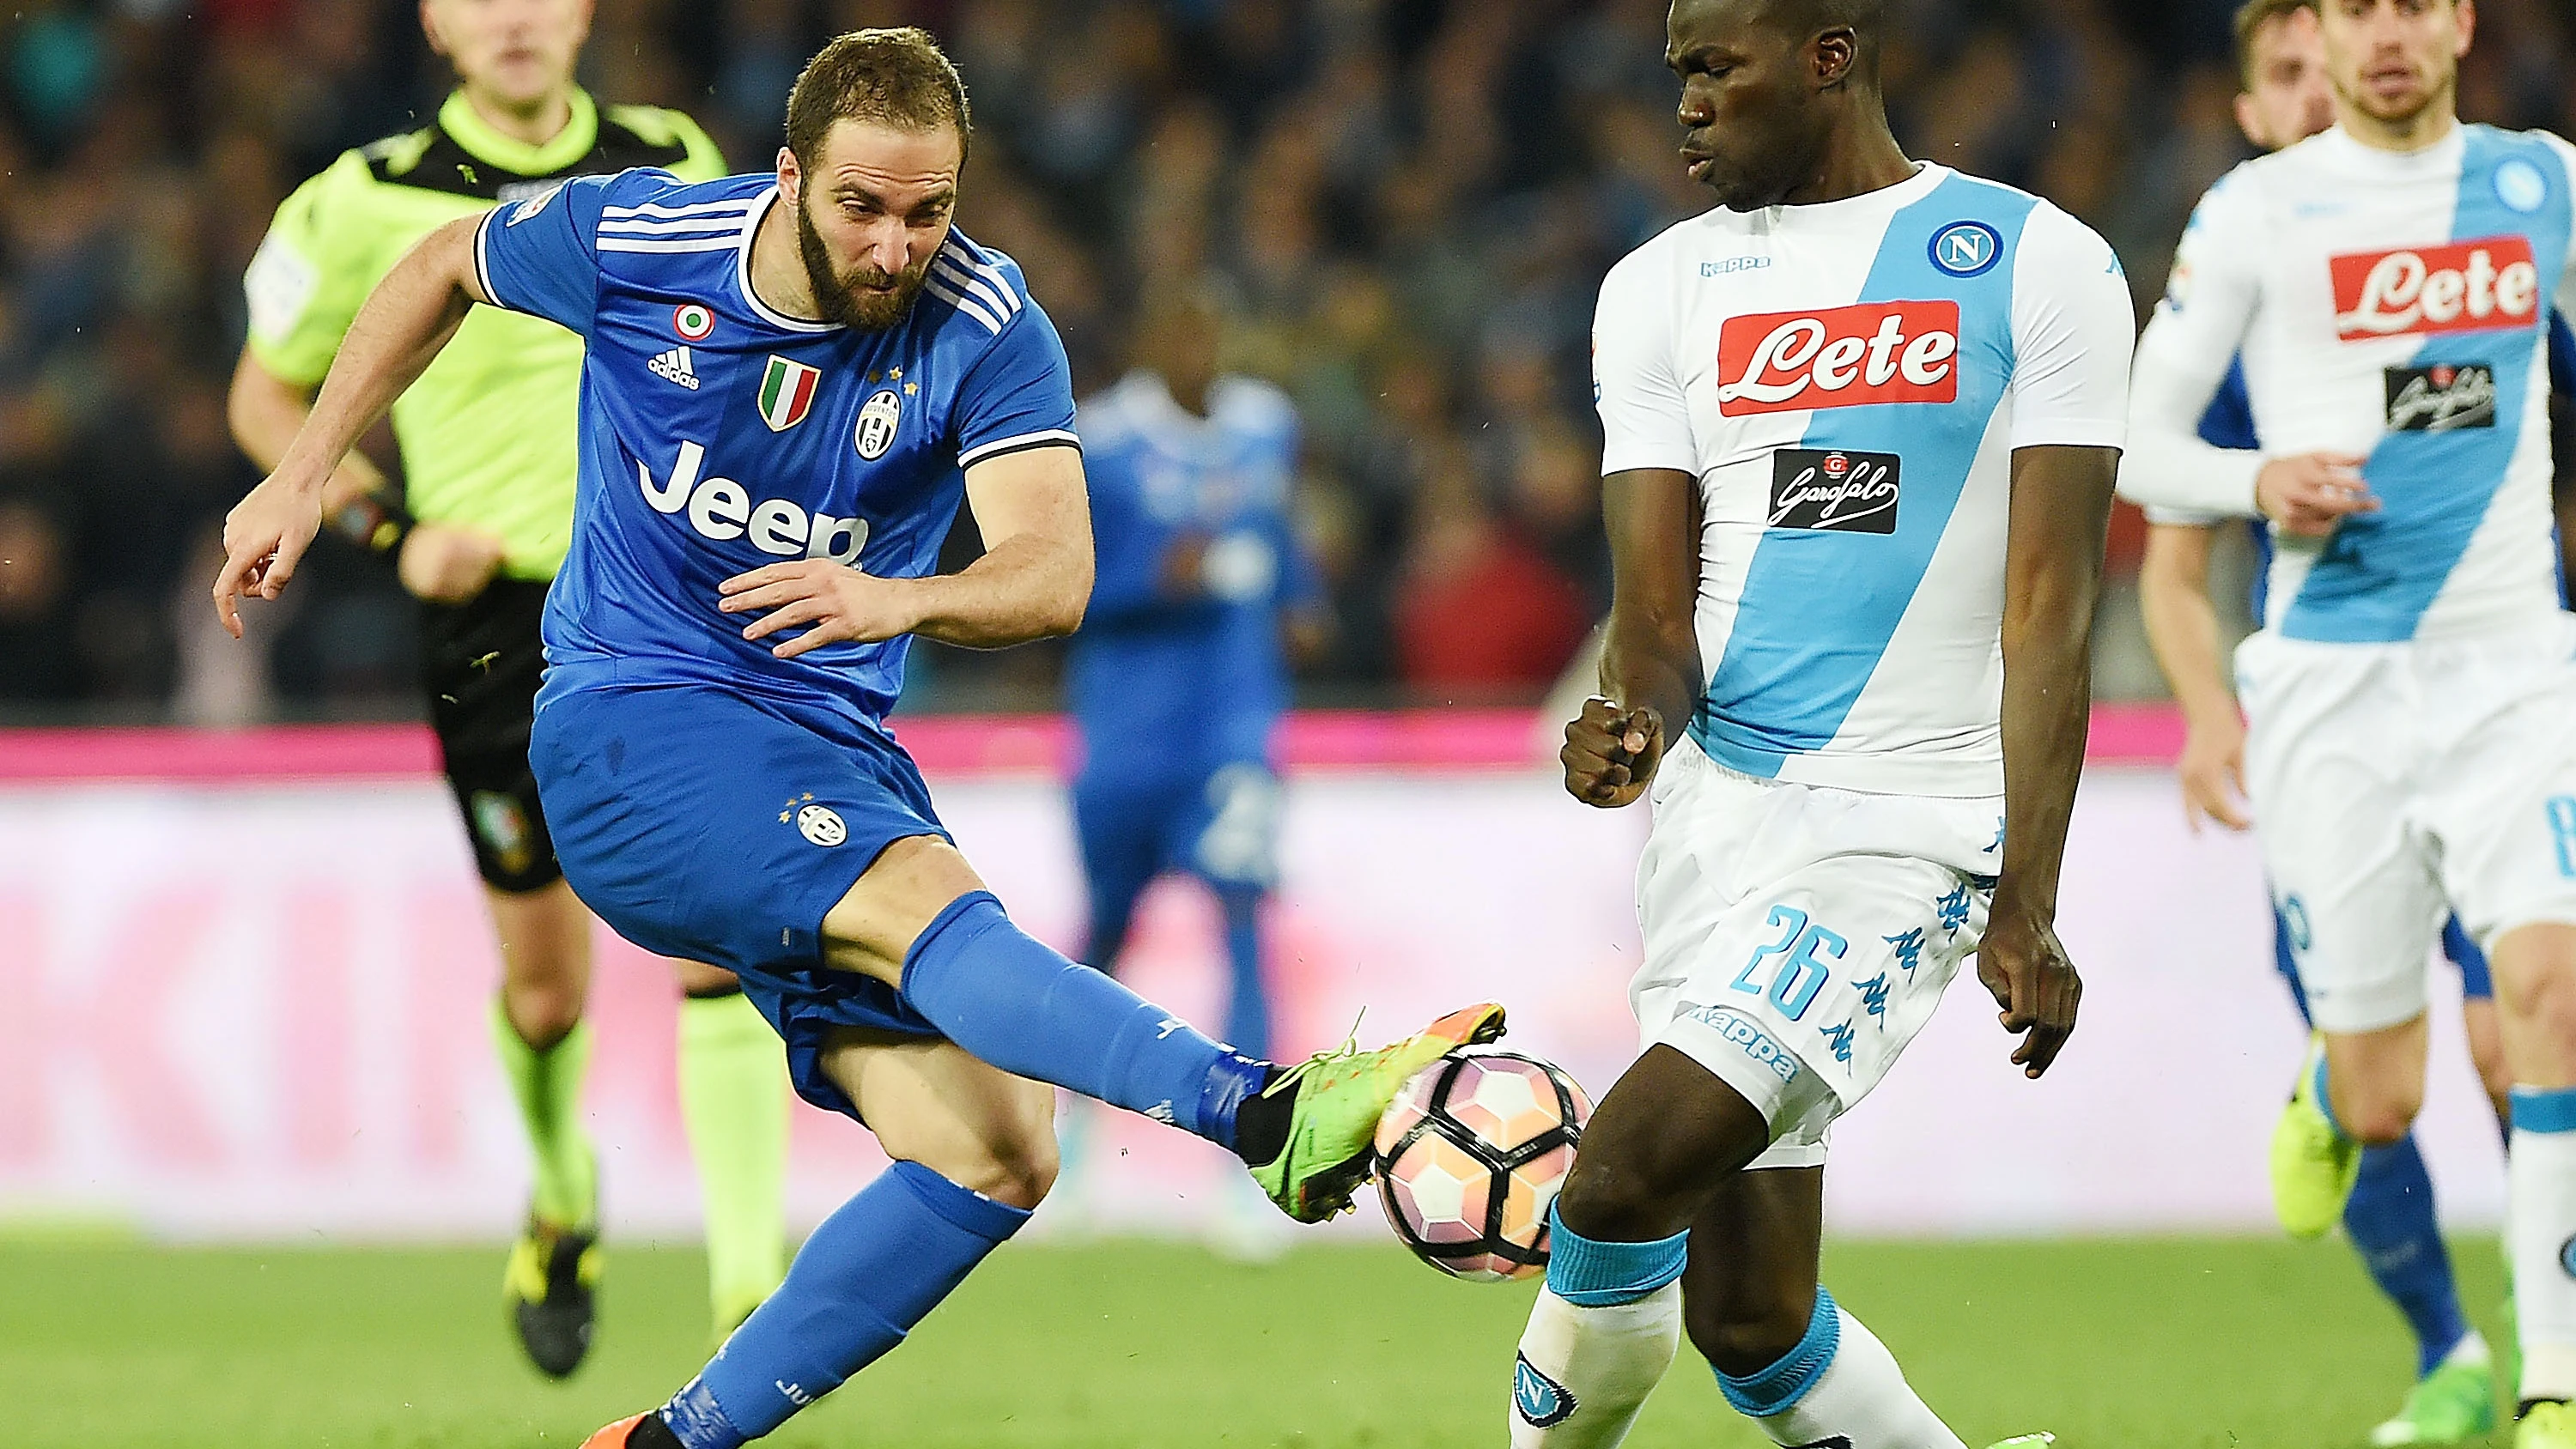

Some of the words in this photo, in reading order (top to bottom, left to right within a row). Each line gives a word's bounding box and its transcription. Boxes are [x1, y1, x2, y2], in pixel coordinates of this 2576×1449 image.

[1948, 234, 1982, 263] N
[2336, 250, 2536, 332] Lete
[647, 359, 700, 391] adidas
[1718, 313, 1957, 403] Lete
[635, 440, 869, 566] Jeep
[1767, 461, 1899, 529] Garofalo
[1730, 904, 1849, 1022] 26
[775, 1379, 815, 1404] JU
[1518, 1366, 1546, 1408] N
